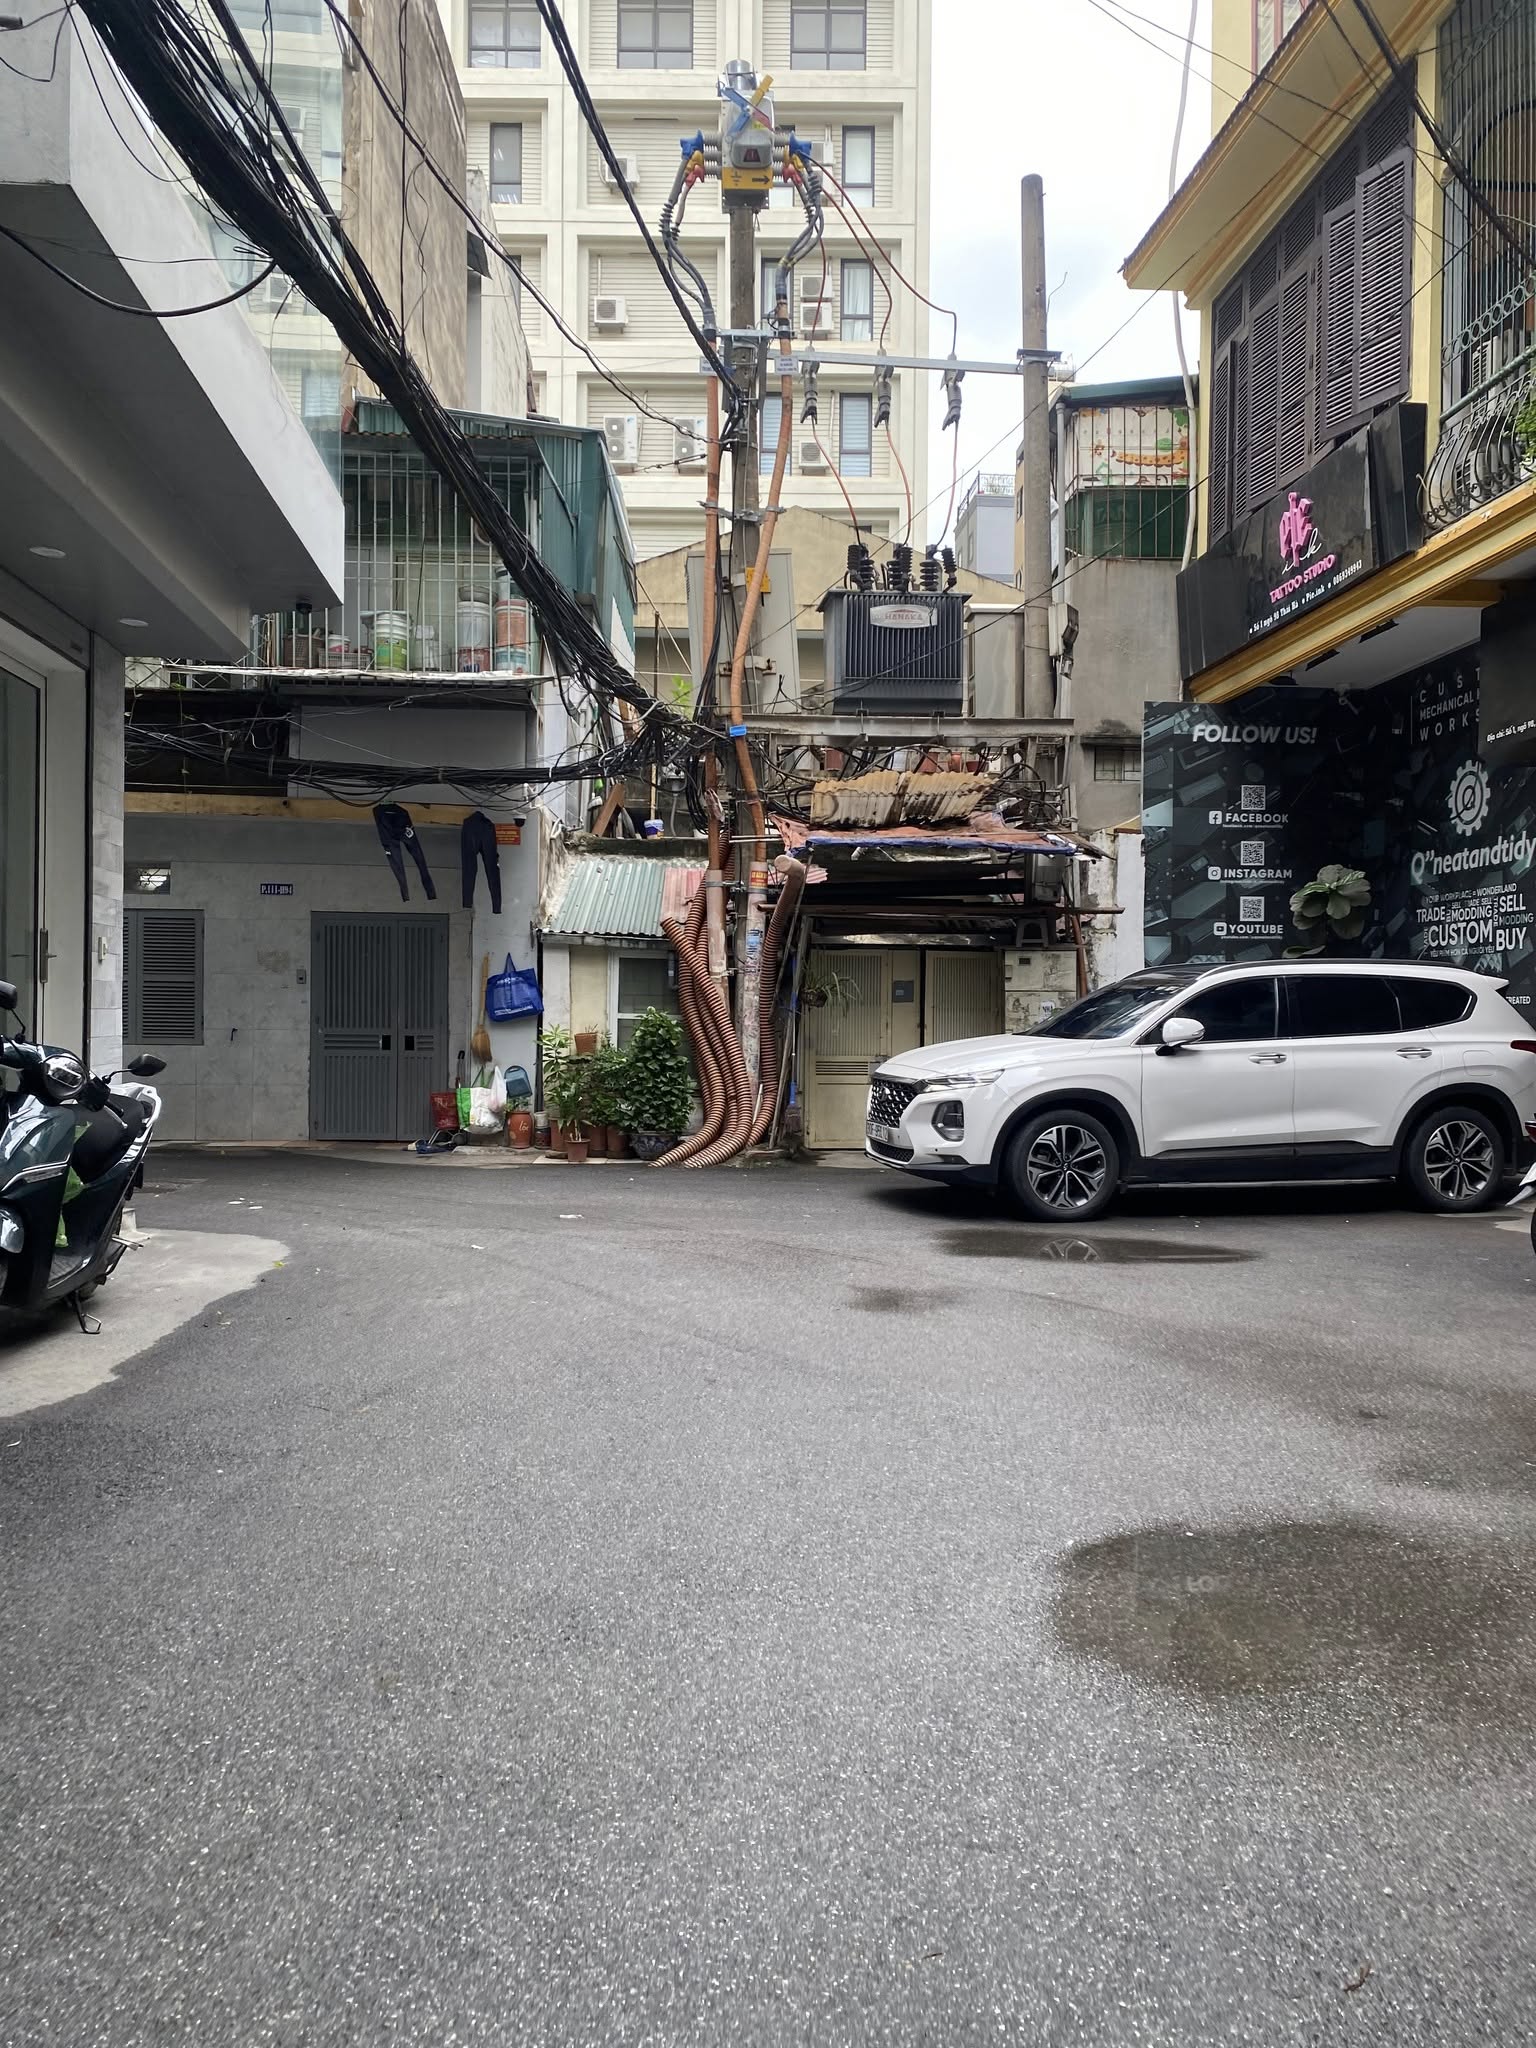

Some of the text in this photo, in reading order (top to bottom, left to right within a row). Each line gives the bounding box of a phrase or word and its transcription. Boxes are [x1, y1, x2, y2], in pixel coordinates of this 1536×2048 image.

[1270, 554, 1336, 603] TATTOO STUDIO
[1420, 690, 1474, 720] MECHANICAL
[1192, 724, 1318, 744] FOLLOW US!
[1226, 813, 1288, 822] FACEBOOK
[1224, 869, 1292, 878] INSTAGRAM
[1476, 883, 1517, 896] WONDERLAND
[1499, 893, 1526, 912] SELL
[1416, 906, 1446, 922] TRADE
[1452, 905, 1492, 922] MODDING
[1499, 912, 1534, 926] MODDING
[1229, 924, 1284, 934] YOUTUBE
[1428, 918, 1492, 947] CUSTOM
[1496, 926, 1527, 951] BUY
